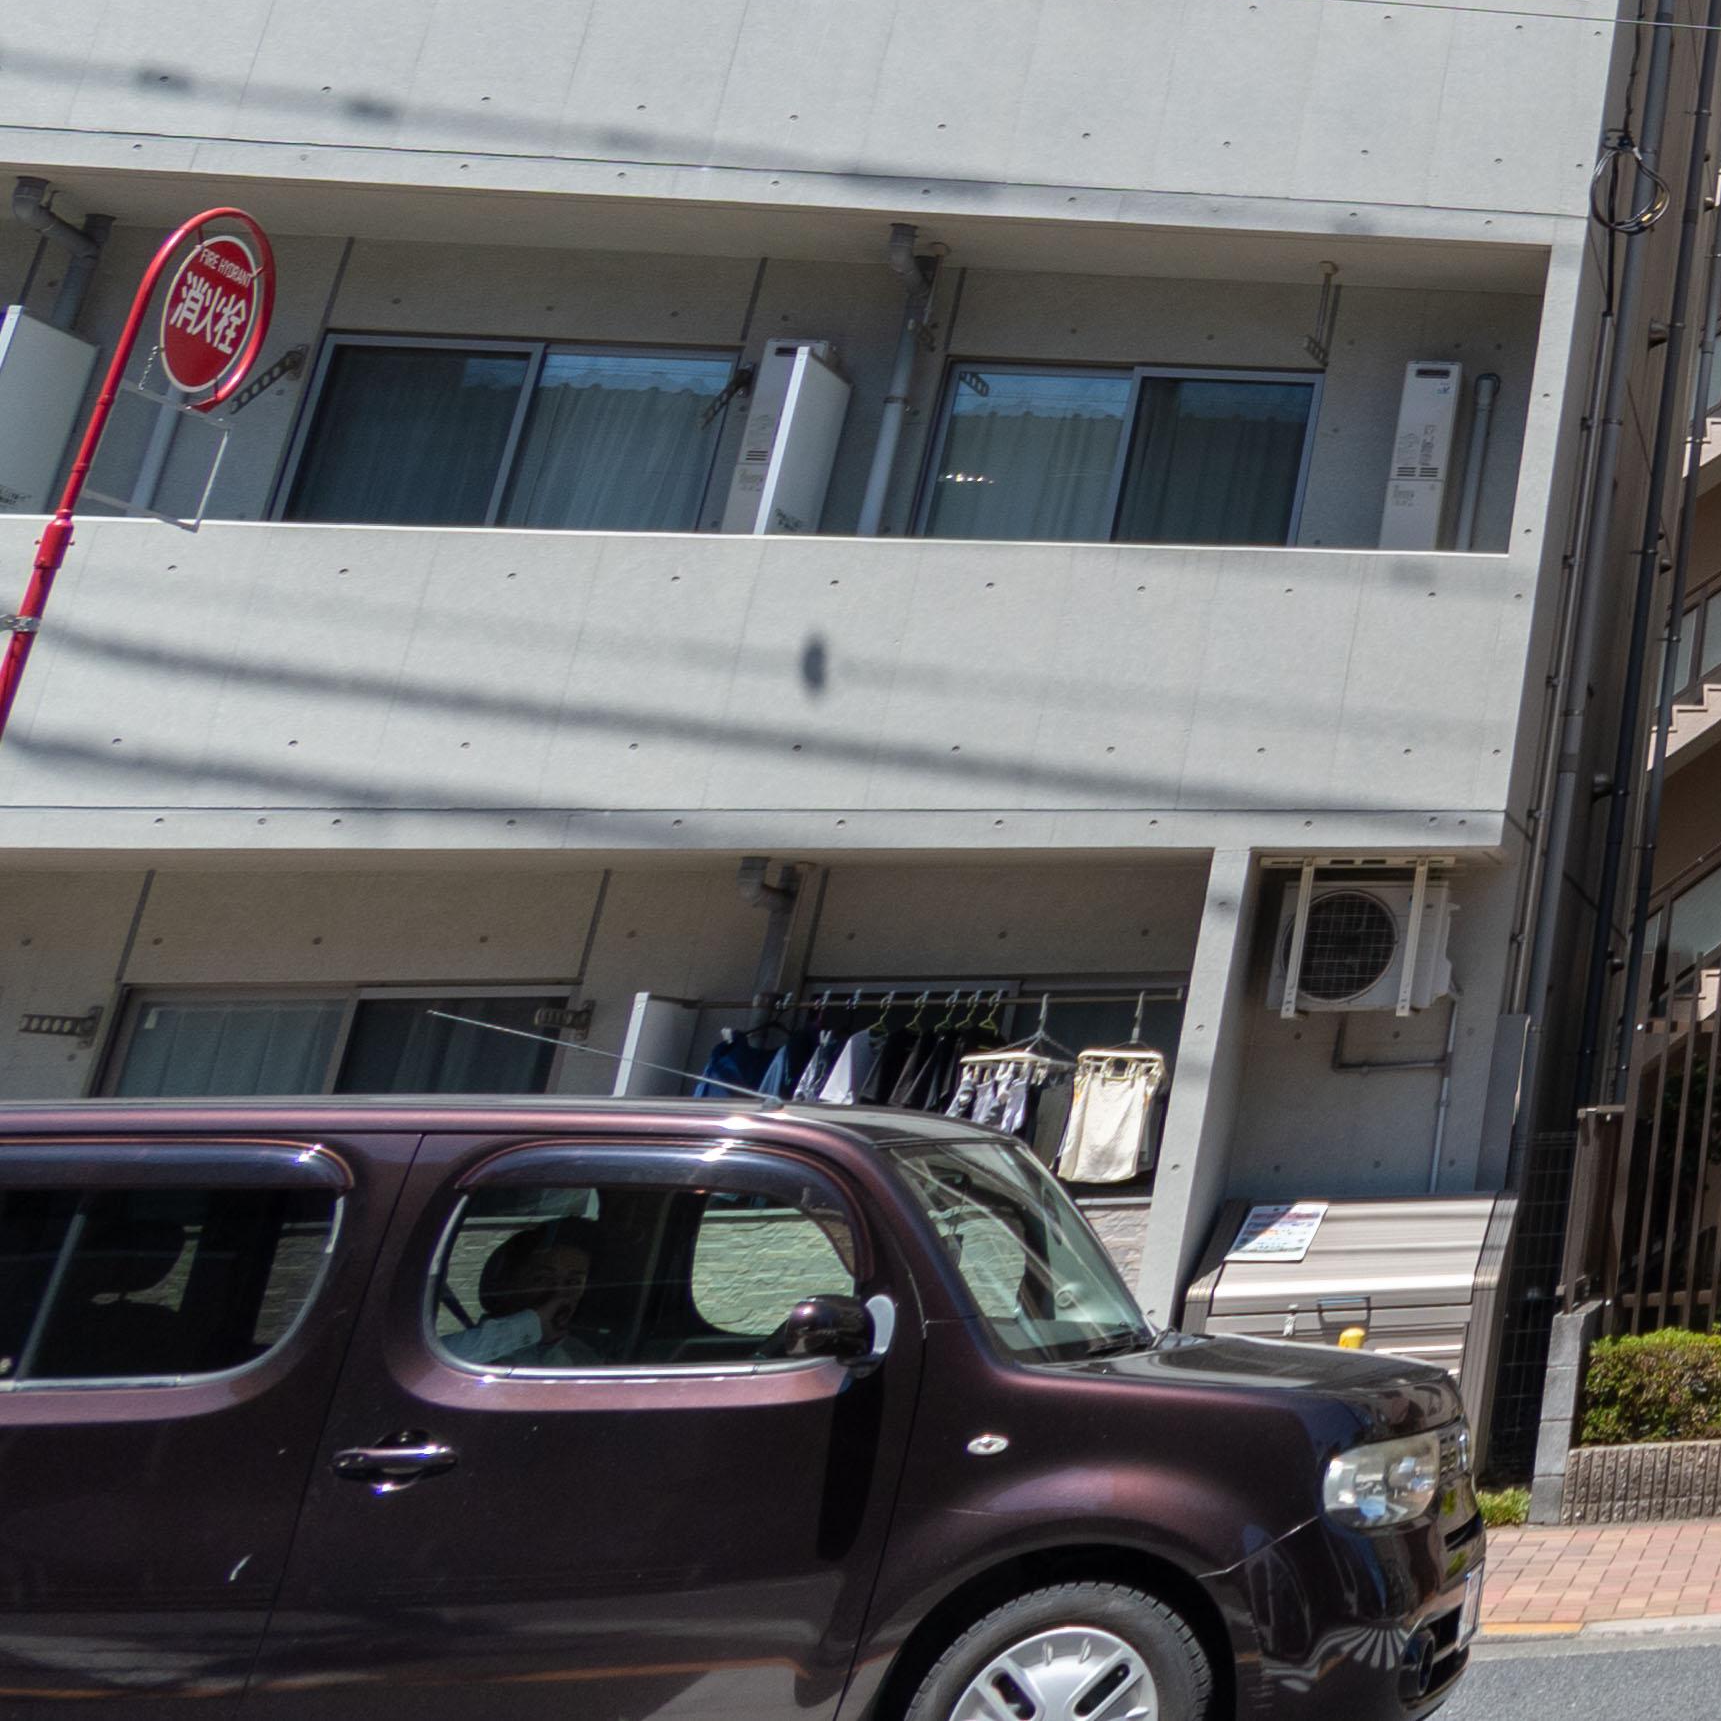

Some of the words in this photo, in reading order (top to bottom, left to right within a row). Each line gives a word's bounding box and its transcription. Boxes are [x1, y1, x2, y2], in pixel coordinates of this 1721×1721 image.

[200, 248, 221, 269] FIRE
[217, 257, 252, 288] HYDRANT
[169, 271, 246, 354] 消火栓
